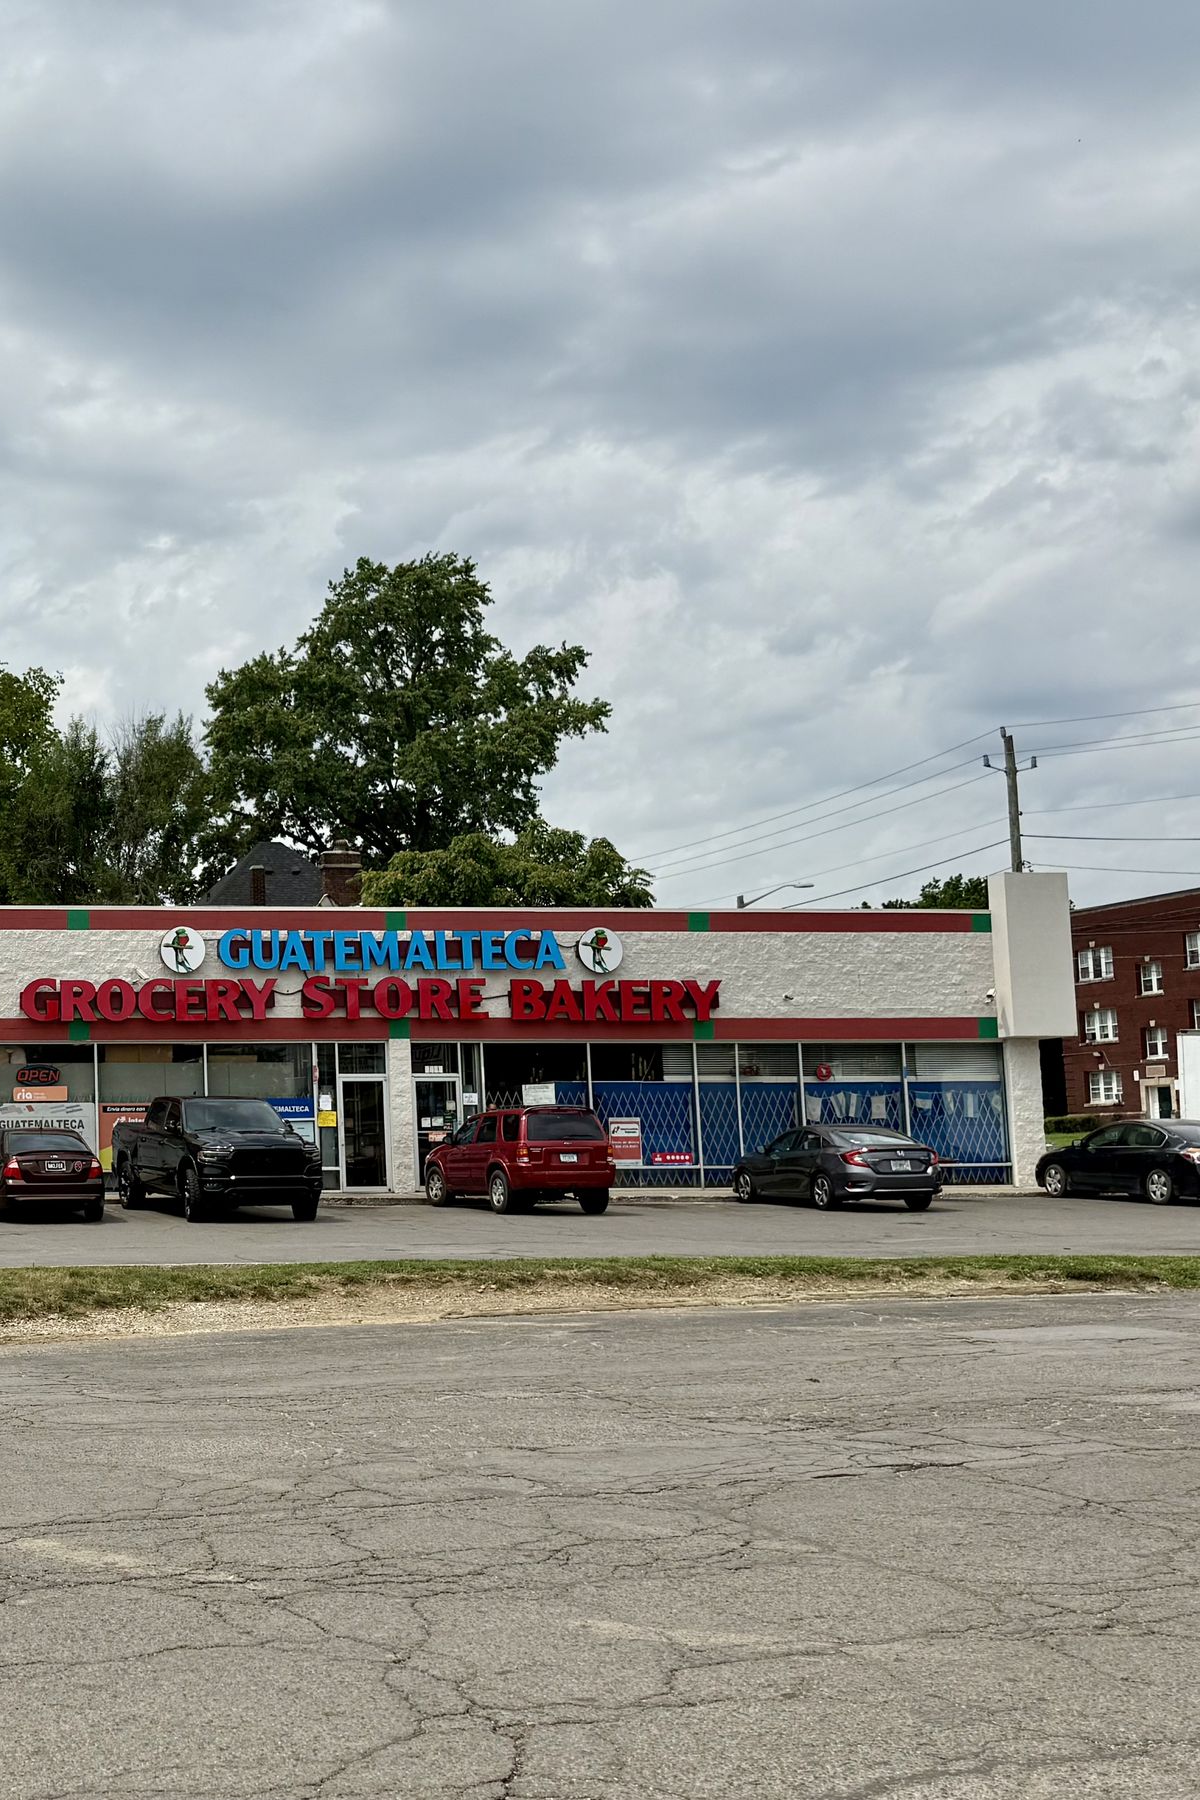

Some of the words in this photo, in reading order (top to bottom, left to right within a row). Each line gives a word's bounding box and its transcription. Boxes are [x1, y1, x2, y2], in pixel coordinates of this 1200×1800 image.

[218, 928, 566, 971] GUATEMALTECA
[20, 978, 278, 1022] GROCERY
[302, 976, 489, 1021] STORE
[510, 978, 722, 1021] BAKERY
[17, 1070, 61, 1082] OPEN
[17, 1089, 33, 1099] ria
[0, 1119, 85, 1129] GUATEMALTECA
